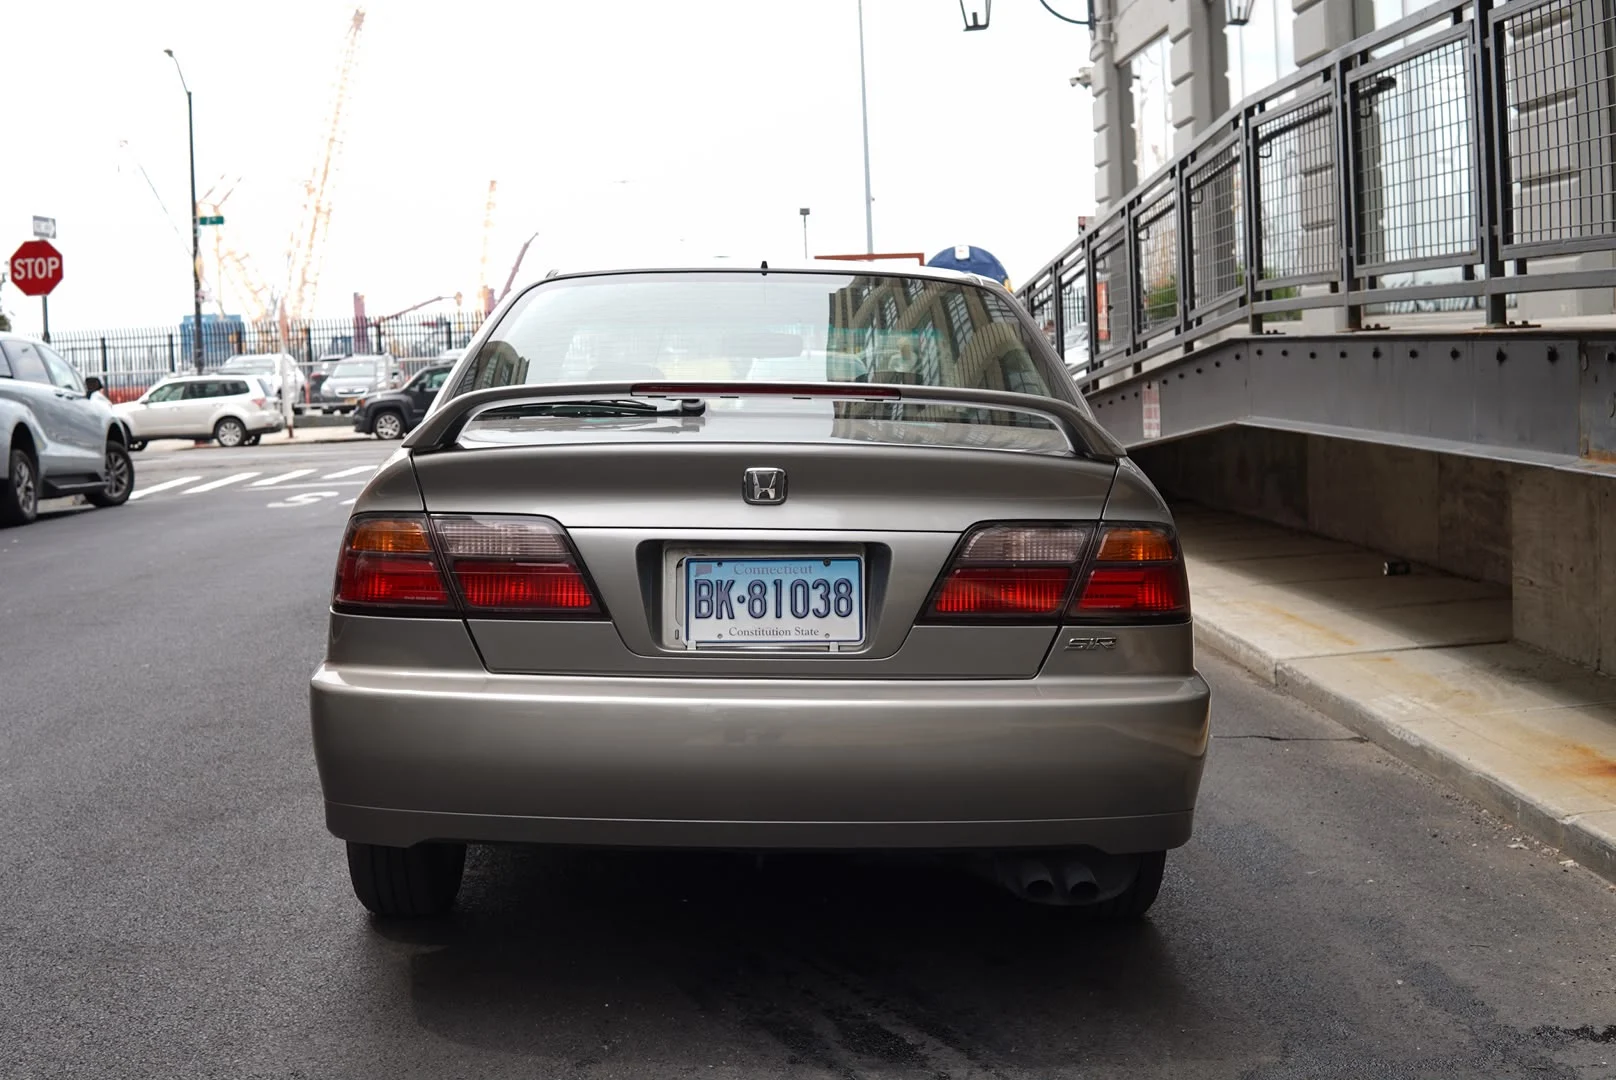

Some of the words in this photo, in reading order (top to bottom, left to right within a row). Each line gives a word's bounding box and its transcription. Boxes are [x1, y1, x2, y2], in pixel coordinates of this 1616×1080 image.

[14, 257, 59, 280] STOP
[733, 563, 812, 575] Connecticut
[728, 627, 791, 637] Constitution
[794, 627, 820, 637] State
